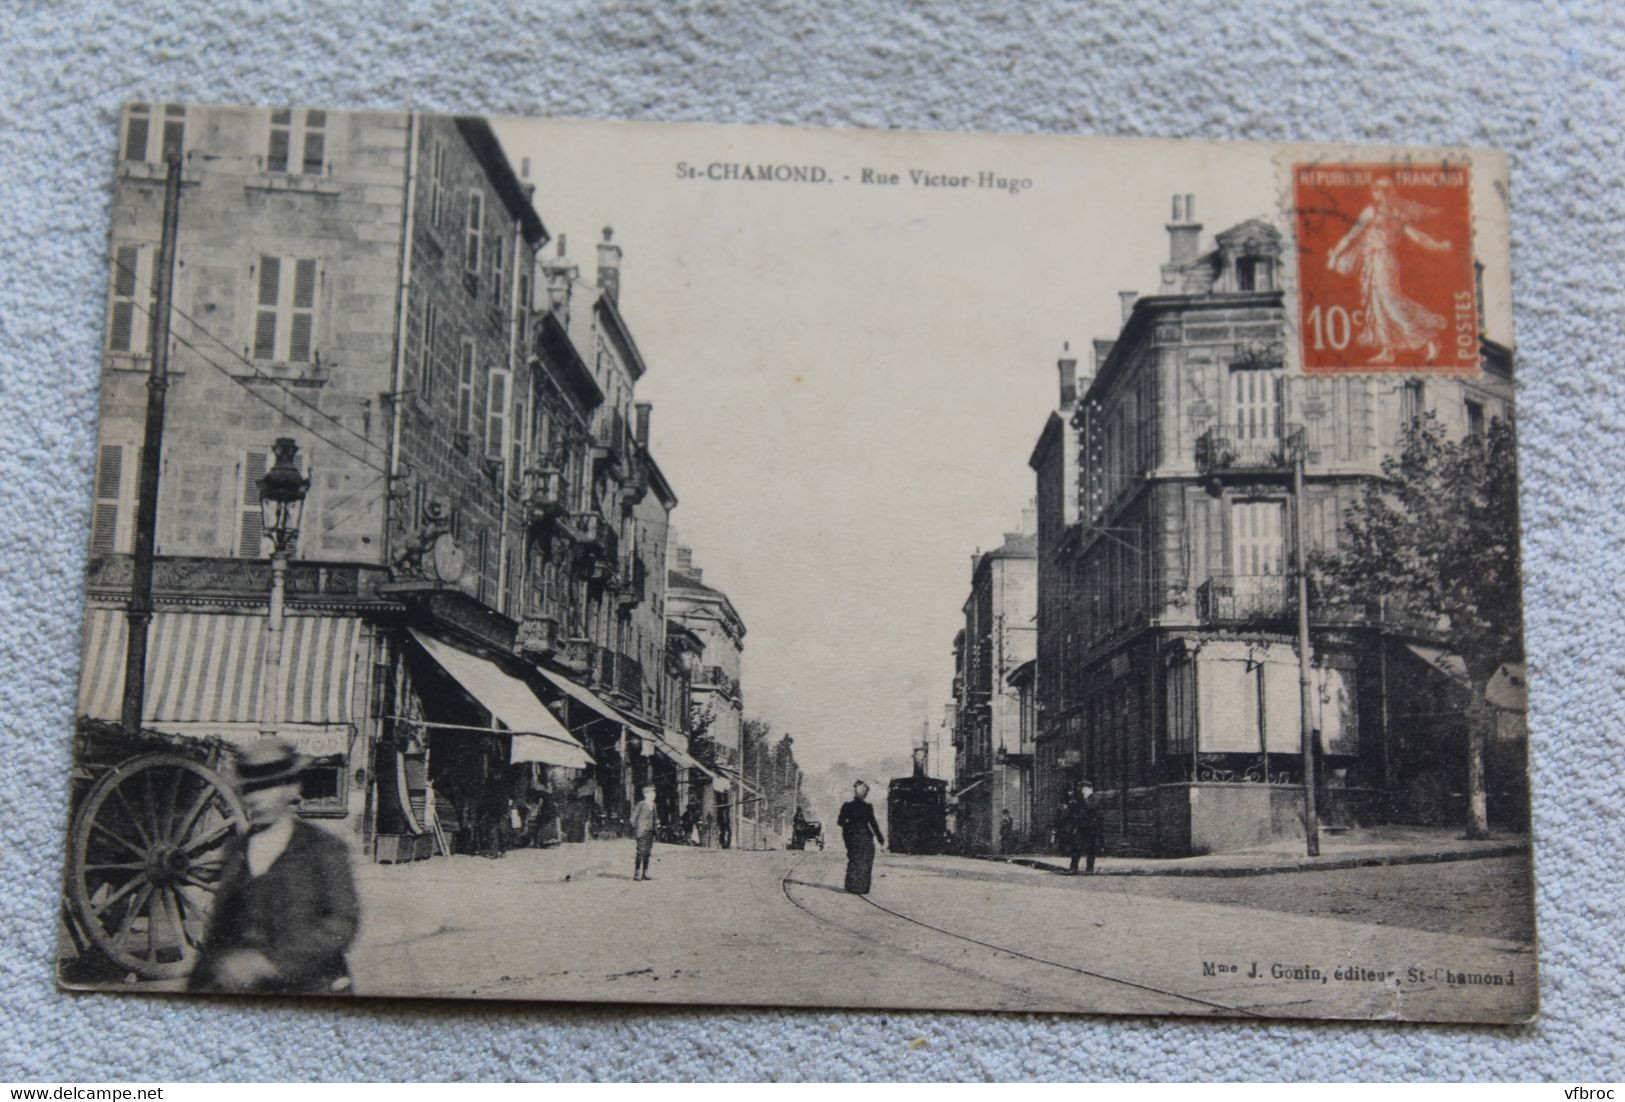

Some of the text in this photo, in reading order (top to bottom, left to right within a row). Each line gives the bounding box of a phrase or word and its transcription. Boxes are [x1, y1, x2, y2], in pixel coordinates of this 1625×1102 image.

[675, 161, 834, 185] St-CHAMOND.
[860, 167, 901, 187] Rue
[908, 168, 1034, 195] Victor-Hugo
[1455, 290, 1475, 361] POSTES
[1202, 961, 1516, 987] Mme J. Gonin, éditeur, St-Chamond
